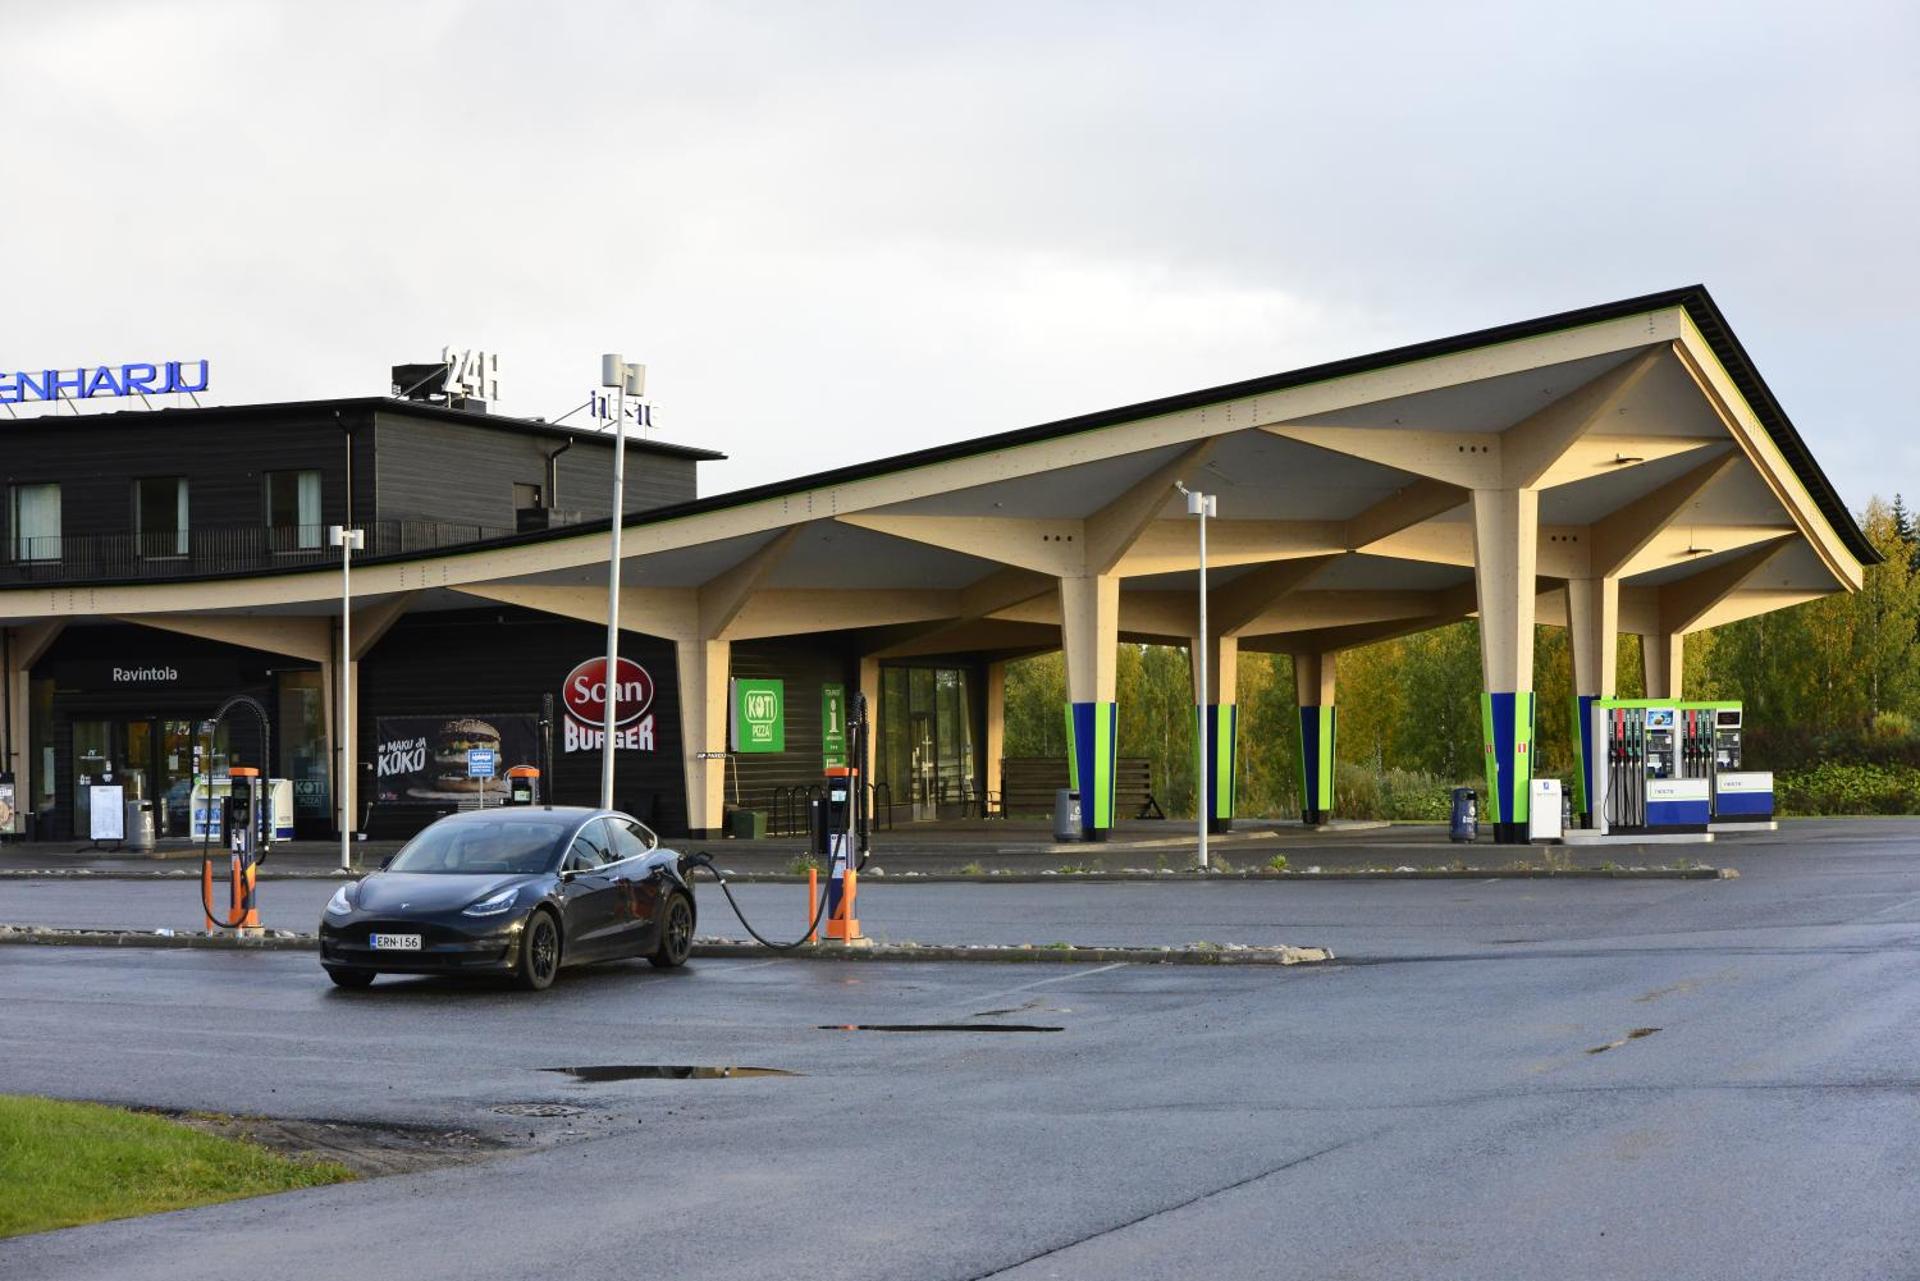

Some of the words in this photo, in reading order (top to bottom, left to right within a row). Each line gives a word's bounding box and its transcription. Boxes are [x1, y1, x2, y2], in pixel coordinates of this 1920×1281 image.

[442, 346, 502, 400] 24H
[113, 666, 178, 681] Ravintola
[575, 676, 642, 704] Scan
[748, 695, 774, 719] KOTI
[564, 714, 653, 753] BURGER
[377, 748, 426, 777] KOKO
[377, 936, 418, 947] ERN-156
